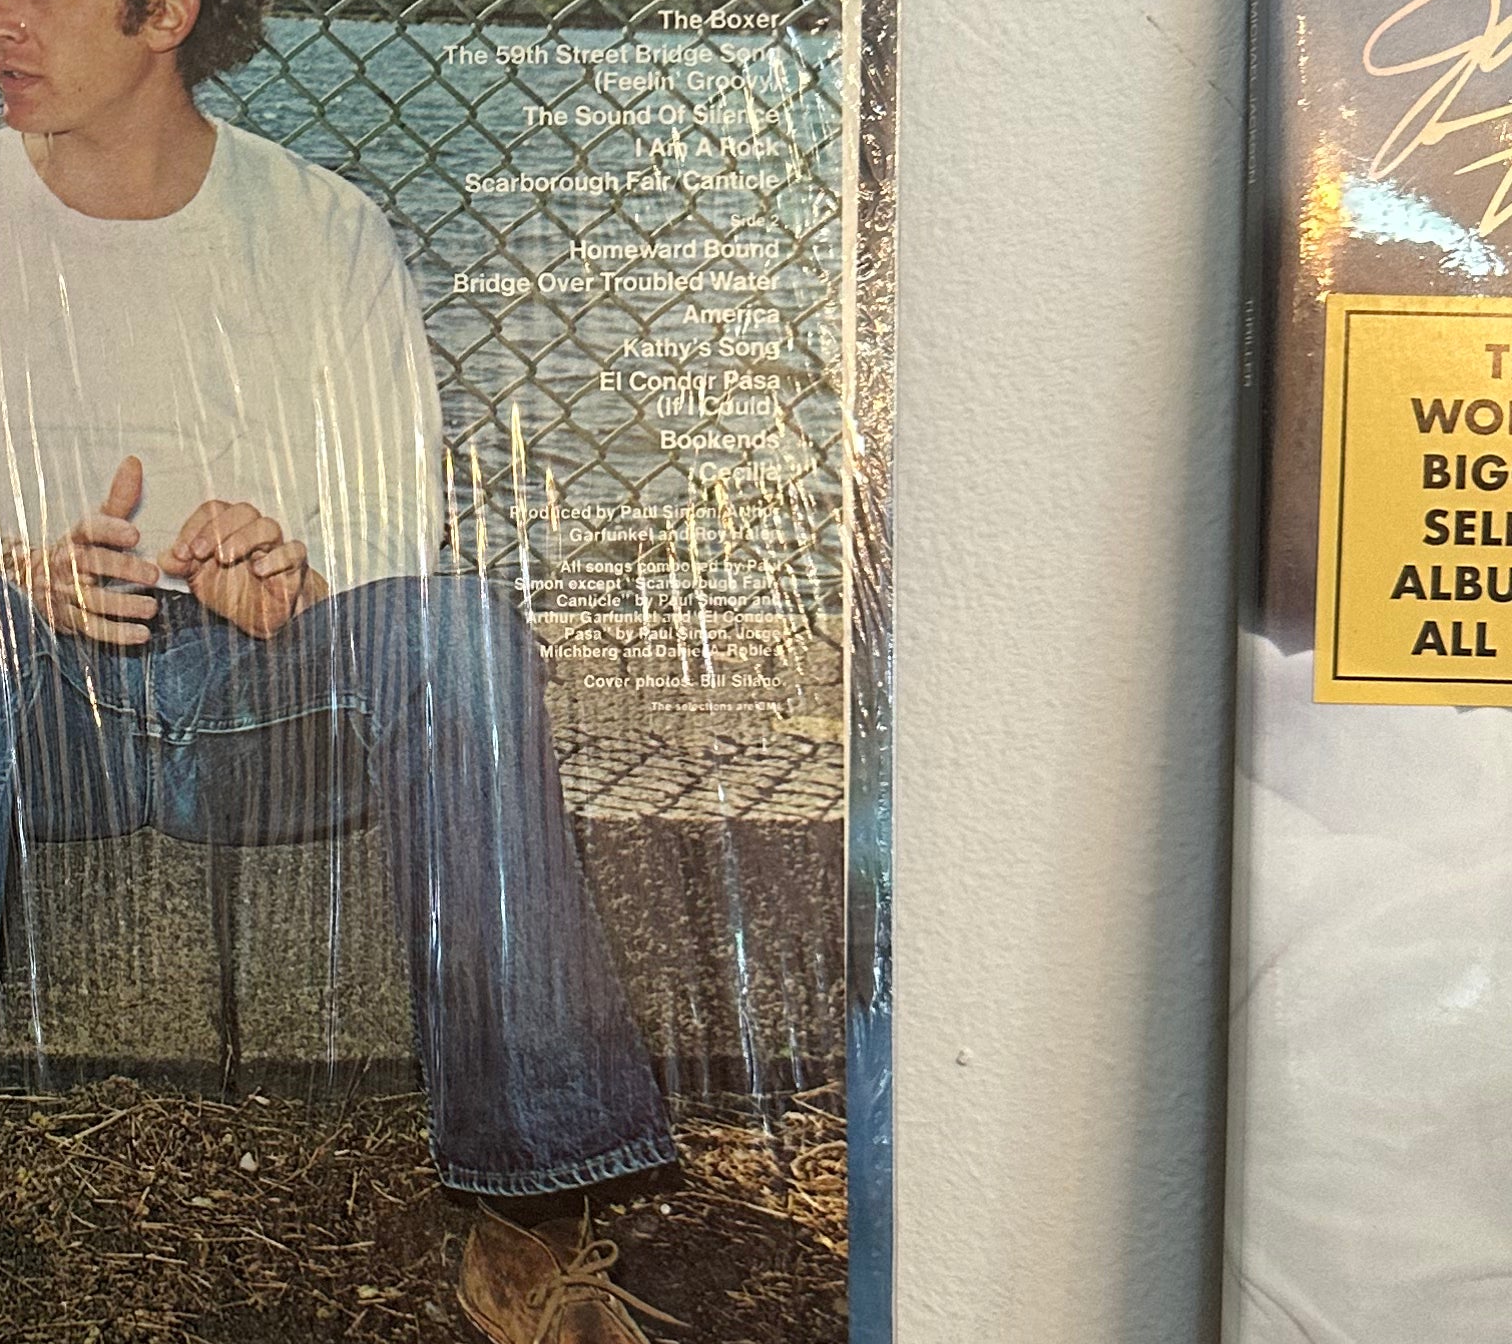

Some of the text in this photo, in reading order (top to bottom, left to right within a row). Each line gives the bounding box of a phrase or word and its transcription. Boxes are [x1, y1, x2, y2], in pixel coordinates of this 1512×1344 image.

[657, 9, 781, 30] The Boxer
[443, 45, 488, 65] The
[495, 45, 548, 65] 59th
[555, 44, 628, 65] Street
[635, 44, 713, 67] Bridge
[594, 70, 681, 94] (Feelin'
[522, 104, 780, 126] The Sound Of Silence
[635, 137, 780, 157] I Am A Rock
[464, 172, 619, 196] Scarborough
[730, 214, 780, 228] Side 2
[569, 238, 779, 260] Homeward Bound
[453, 270, 780, 297] Bridge Over Troubled Water
[682, 304, 780, 324] America
[623, 337, 781, 362] Kathy's Song
[599, 369, 781, 392] El Condor Pasa
[656, 395, 681, 418] (If
[660, 429, 781, 450] Bookends
[698, 460, 779, 482] Cecilia
[509, 505, 591, 520] Poduced
[596, 505, 617, 521] by
[620, 505, 658, 519] Paul
[569, 527, 655, 542] Garfunkel
[658, 527, 688, 542] and
[695, 526, 726, 543] Roy
[560, 560, 581, 574] All
[585, 561, 632, 576] songs
[637, 561, 718, 576] compoed
[724, 560, 745, 575] by
[514, 577, 564, 591] Smon
[568, 578, 621, 593] except
[556, 593, 782, 609] Canticle" by Paul Simon and
[526, 611, 575, 624] Arthur
[564, 626, 611, 641] Pasa"
[615, 627, 635, 642] by
[638, 626, 673, 641] Paul
[735, 627, 782, 642] Jorge
[1410, 620, 1498, 658] ALL
[539, 644, 619, 661] Milchberg
[622, 644, 652, 658] and
[655, 644, 707, 658] Danie
[583, 674, 630, 688] Cover
[700, 673, 725, 688] Bill
[650, 701, 671, 712] The
